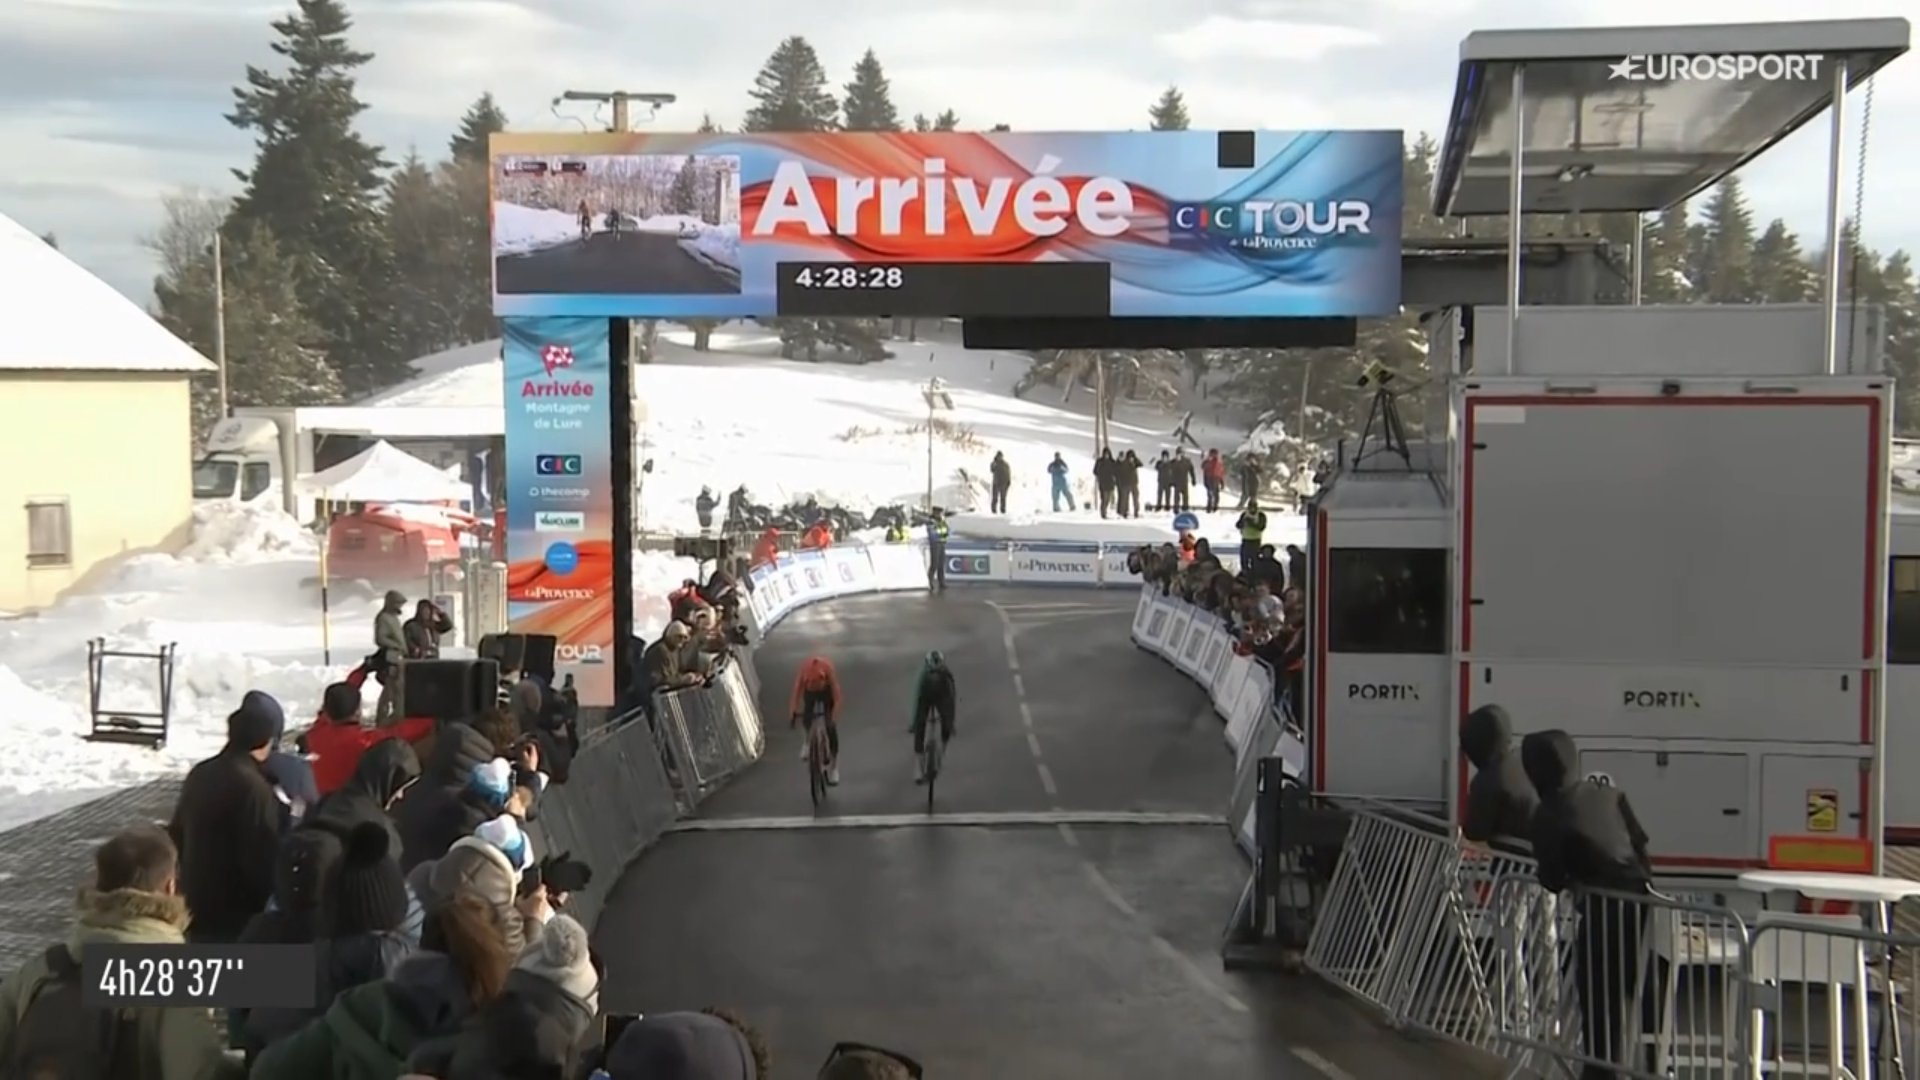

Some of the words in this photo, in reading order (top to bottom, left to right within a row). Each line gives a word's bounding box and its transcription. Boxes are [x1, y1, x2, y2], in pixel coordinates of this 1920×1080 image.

[752, 154, 1134, 236] Arrivée
[1175, 206, 1233, 229] CIC
[1243, 200, 1372, 235] TOUR
[796, 267, 902, 288] 4:28:28
[521, 380, 594, 397] Arrivée
[525, 402, 591, 415] Montagne
[533, 418, 550, 429] de
[553, 417, 582, 429] Lure
[539, 457, 579, 472] CIC
[947, 557, 987, 573] CIC
